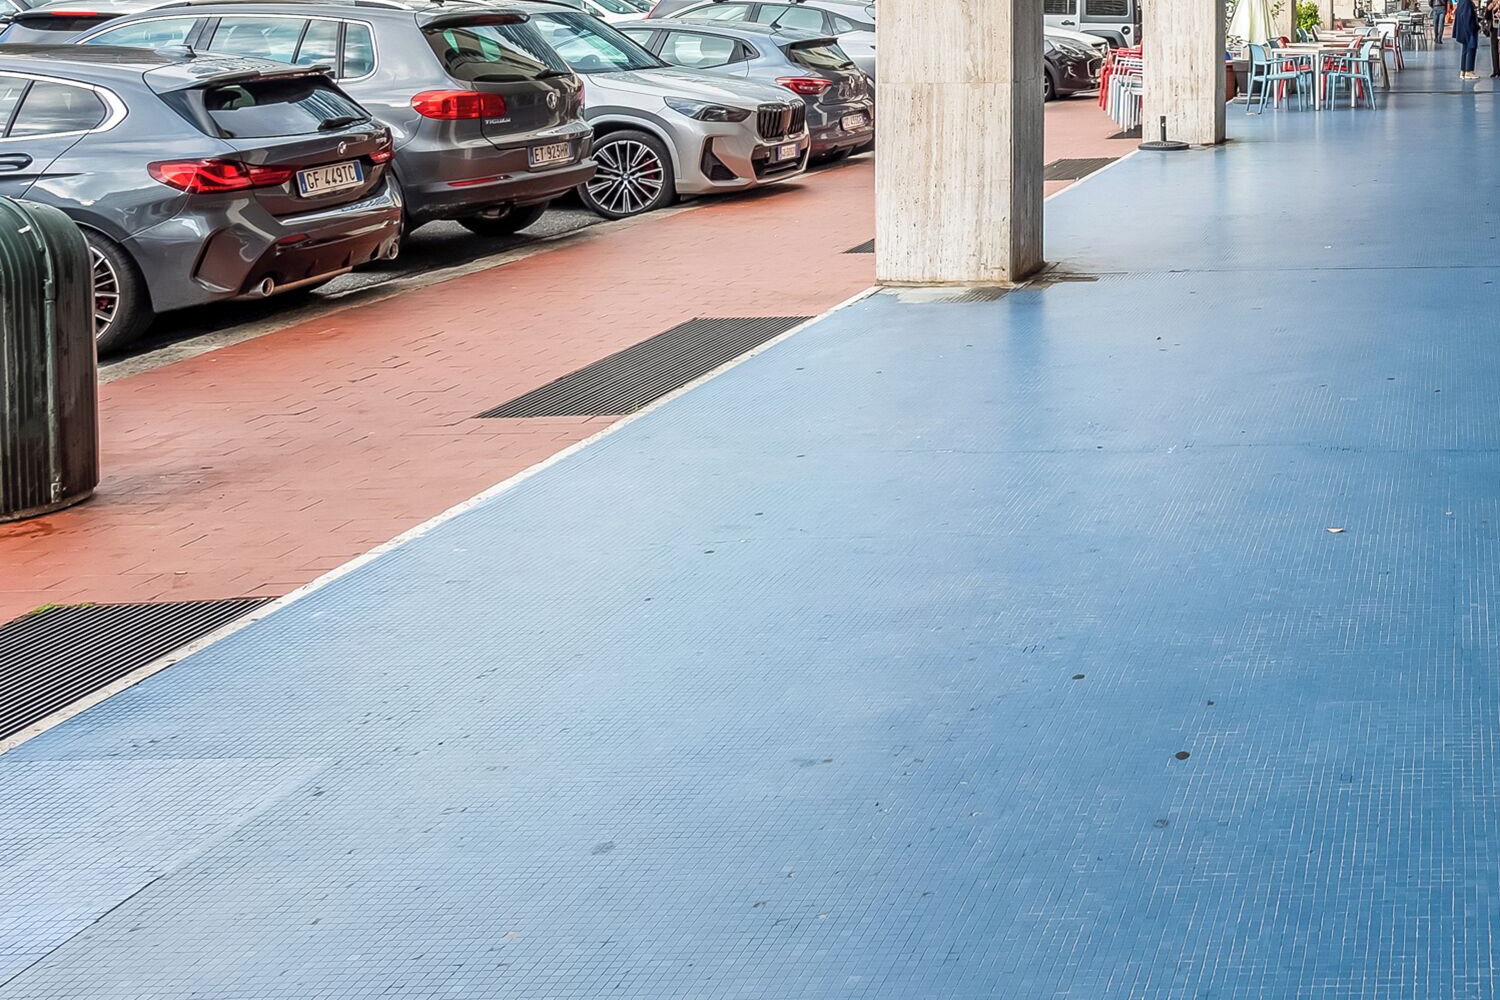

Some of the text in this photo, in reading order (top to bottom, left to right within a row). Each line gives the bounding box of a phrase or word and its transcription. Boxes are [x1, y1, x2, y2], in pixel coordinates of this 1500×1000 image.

[534, 146, 546, 162] ET
[305, 164, 356, 190] GF 449TC
